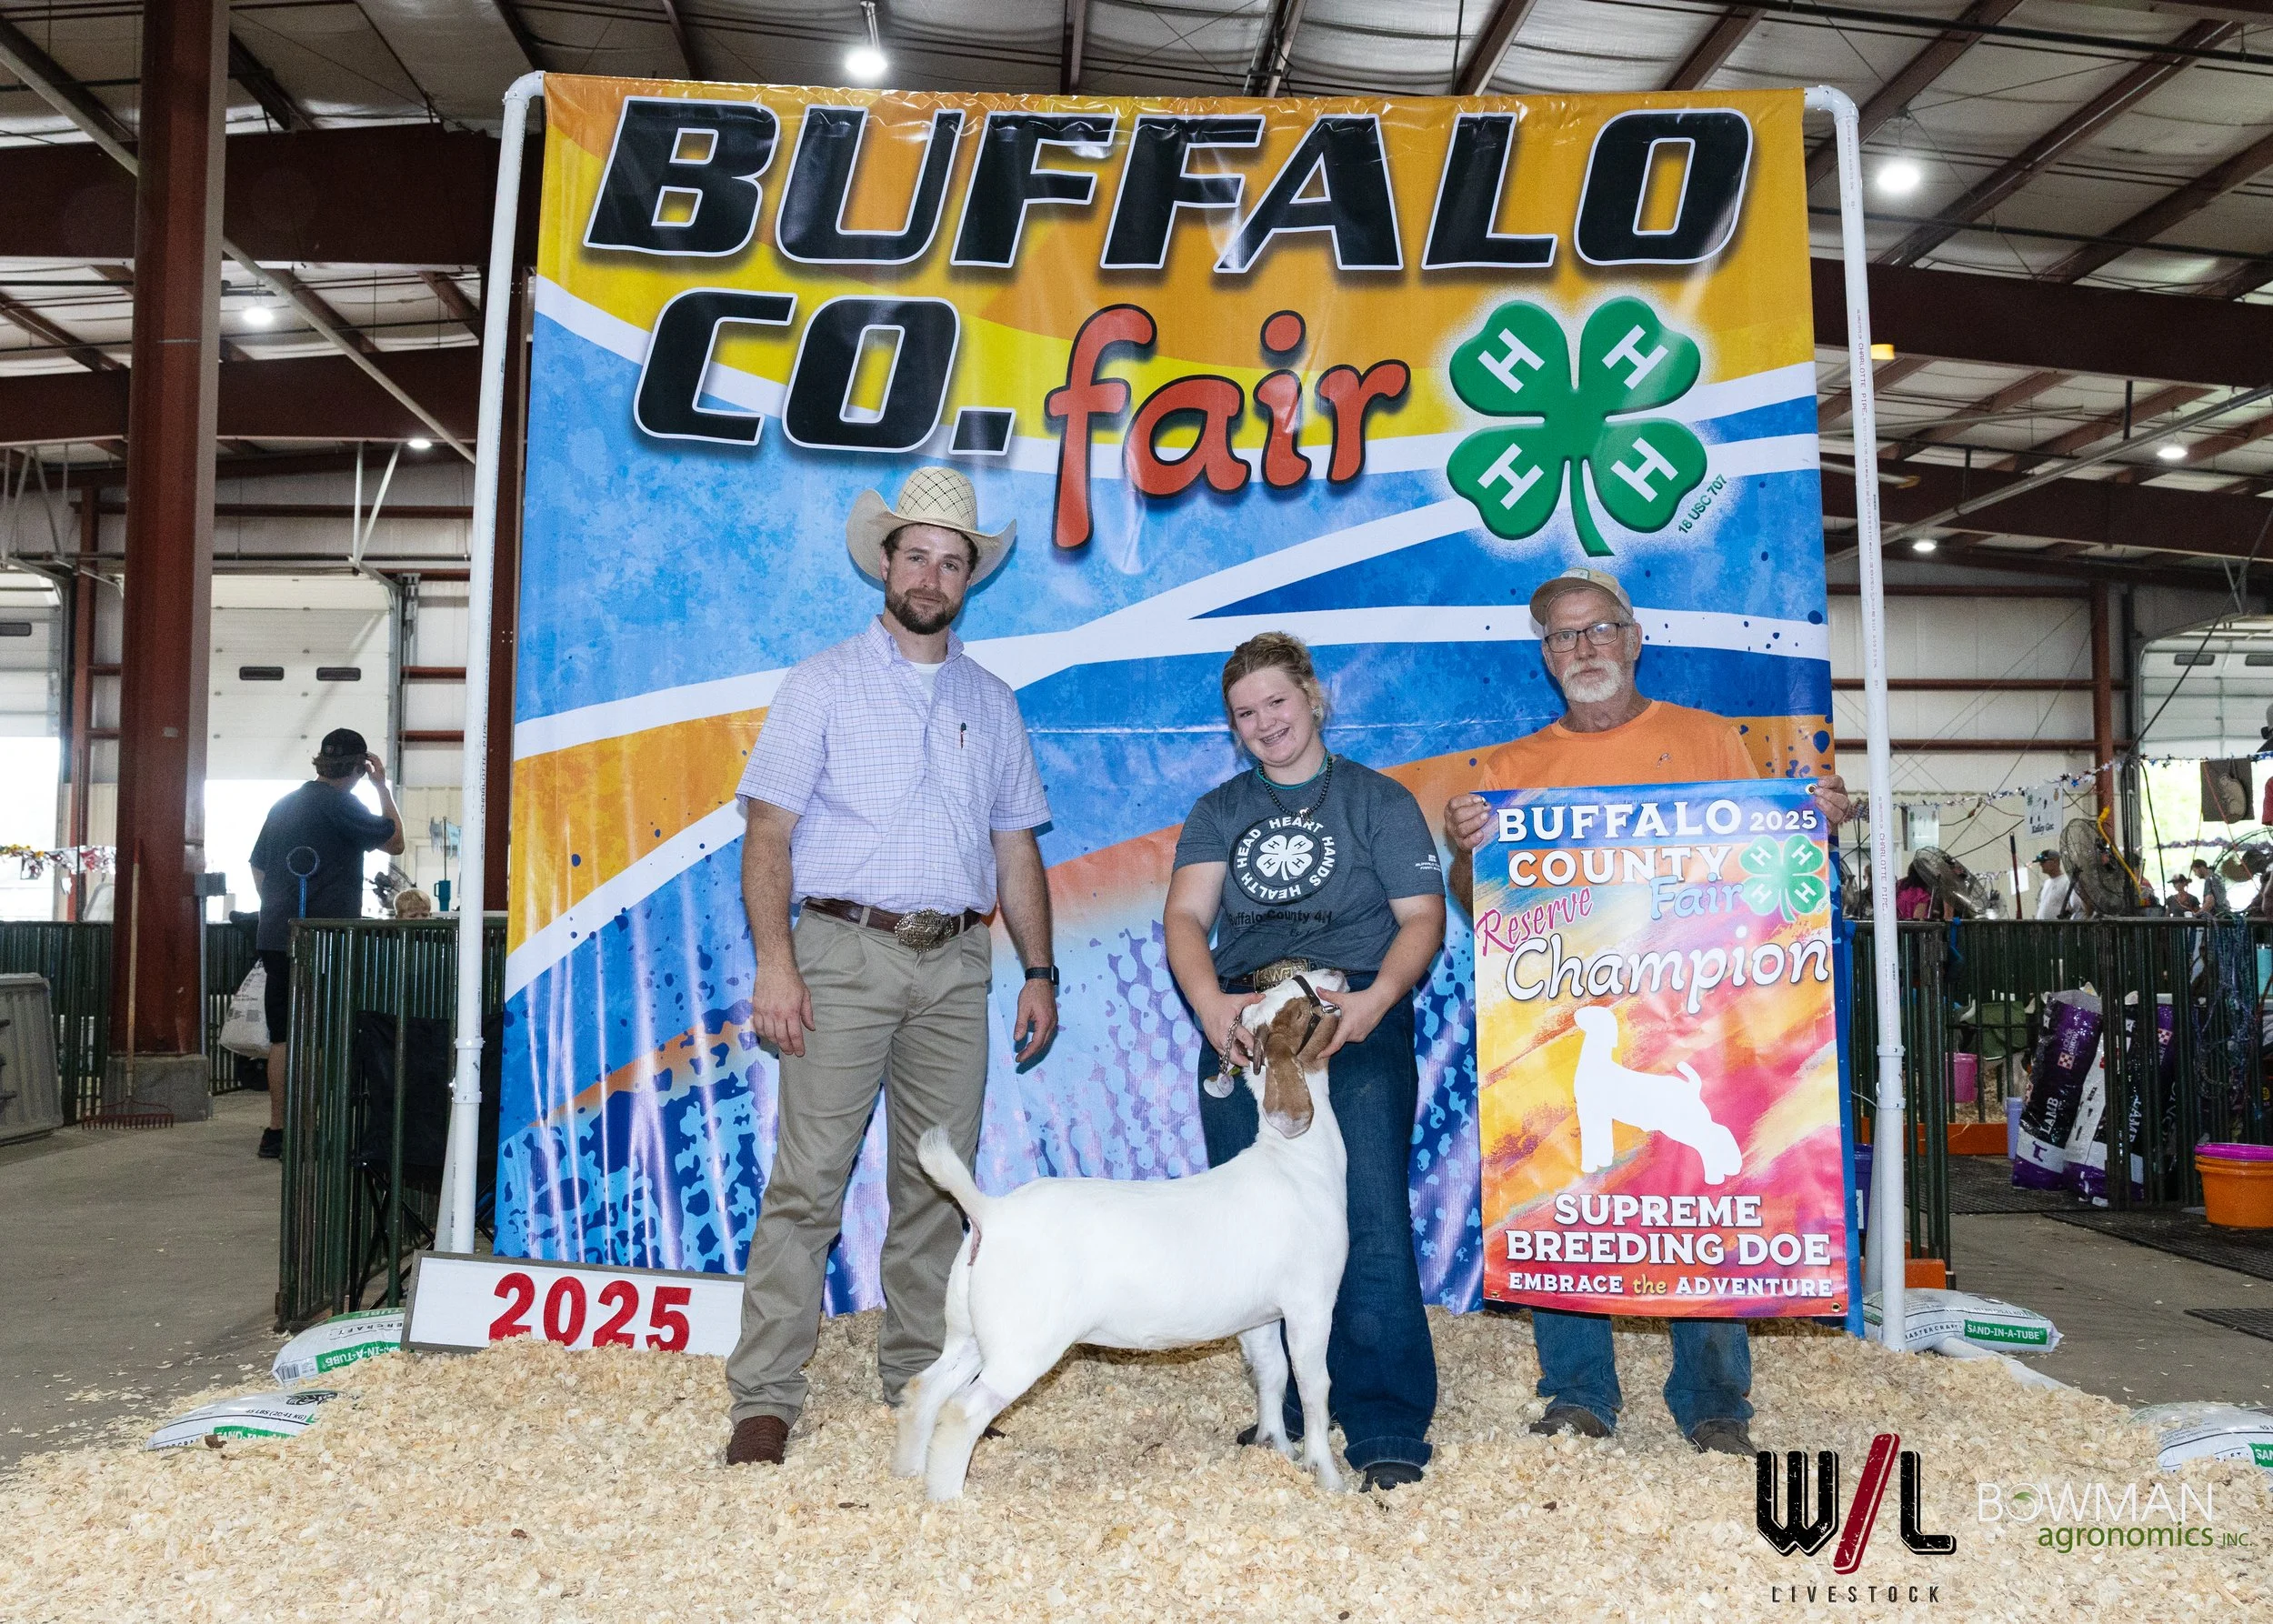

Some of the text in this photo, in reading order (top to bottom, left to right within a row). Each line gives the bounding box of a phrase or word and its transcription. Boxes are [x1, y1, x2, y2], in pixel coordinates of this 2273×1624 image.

[583, 95, 1753, 272] BUFFALO
[1477, 324, 1668, 393] H H
[1858, 343, 1867, 387] CHARLOTTE
[634, 287, 1411, 551] CO. fair
[1477, 437, 1679, 510] H H
[1678, 475, 1727, 534] 18 USC 707
[1497, 799, 1817, 843] BUFFALO 2025
[1237, 817, 1336, 900] HEAD HEART HANDS HEALTH
[1263, 857, 1305, 869] H H
[1267, 840, 1307, 849] H H
[1507, 845, 1733, 887] COUNTY
[1747, 844, 1815, 867] H H
[1266, 909, 1310, 924] County
[1649, 872, 1745, 921] Fair
[1474, 887, 1593, 957] Reserve
[1506, 926, 1829, 1015] Champion
[2040, 1097, 2058, 1135] LAMB
[1553, 1193, 1762, 1227] SUPREME
[1505, 1229, 1831, 1266] BREEDING DOE
[1508, 1272, 1834, 1298] EMBRACE the ADVENTURE
[337, 1321, 403, 1336] ERCRAFT
[489, 1272, 692, 1352] 2025
[1967, 1324, 2040, 1340] SAND-IN-A-TUBE
[325, 1346, 397, 1367] -IN-A-TUBE
